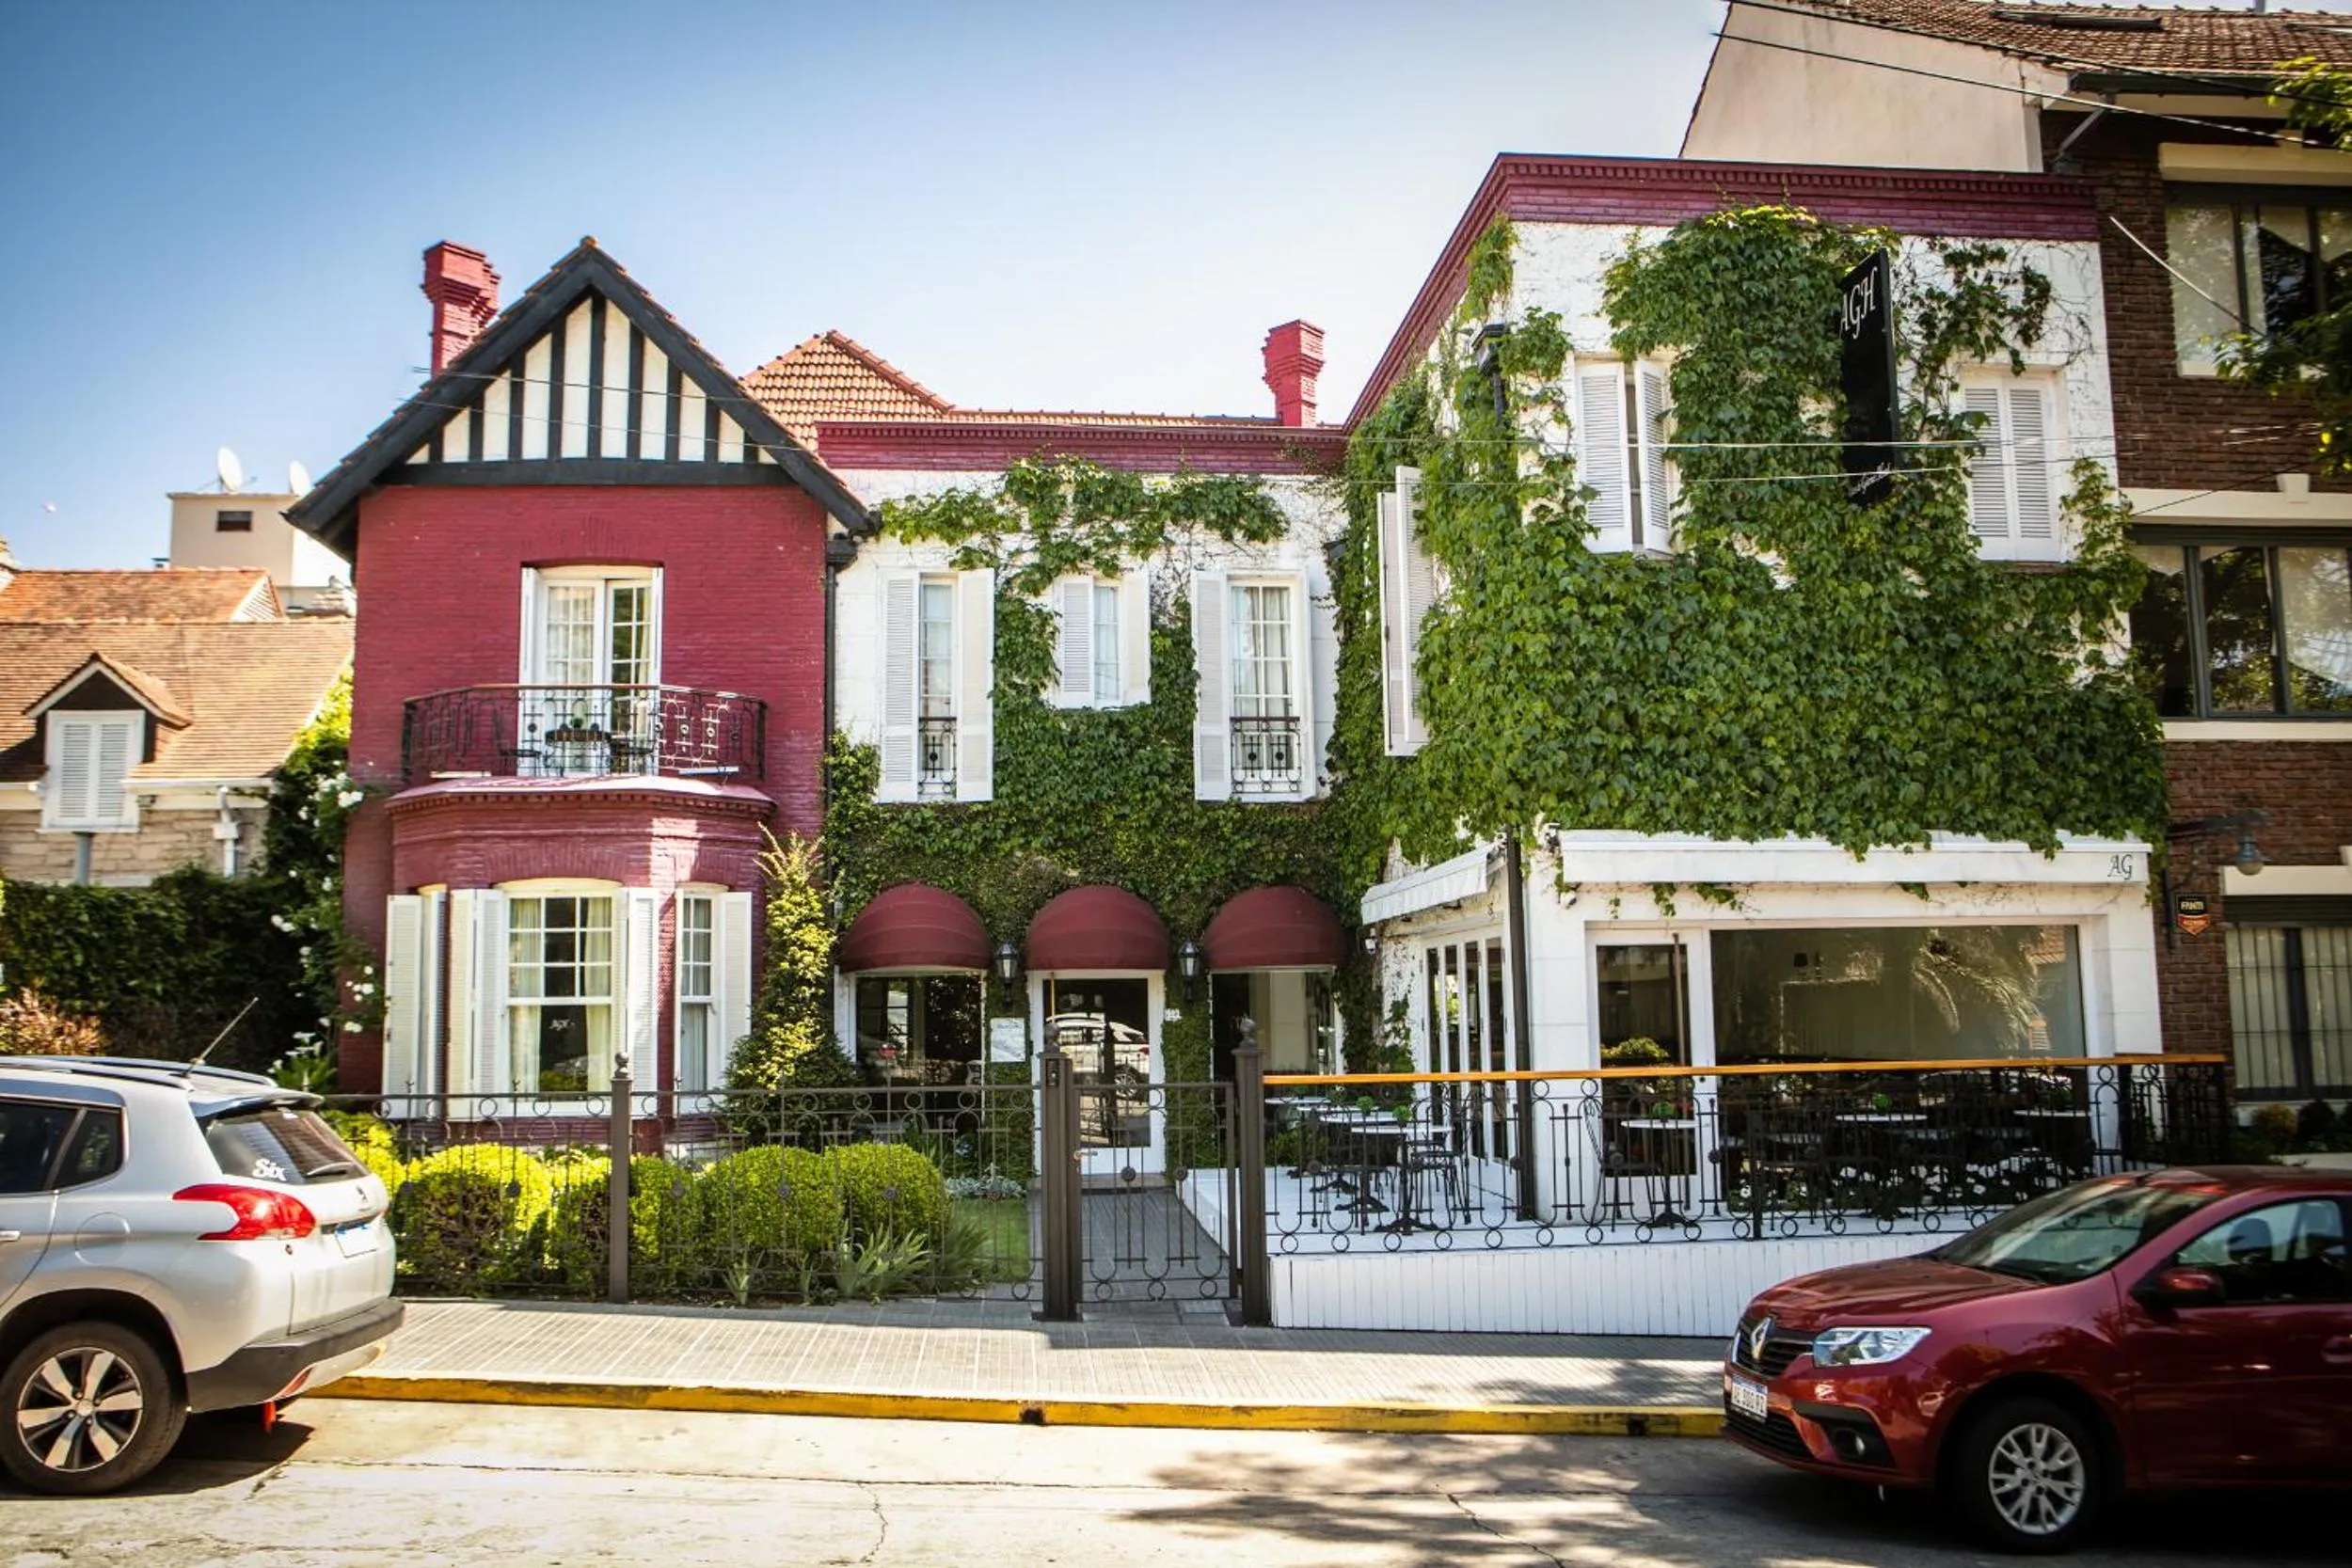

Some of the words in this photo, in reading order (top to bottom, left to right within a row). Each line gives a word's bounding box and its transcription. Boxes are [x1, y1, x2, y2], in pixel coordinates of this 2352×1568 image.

[1838, 266, 1878, 340] AGH
[2107, 854, 2133, 880] AG
[251, 1158, 287, 1181] Six
